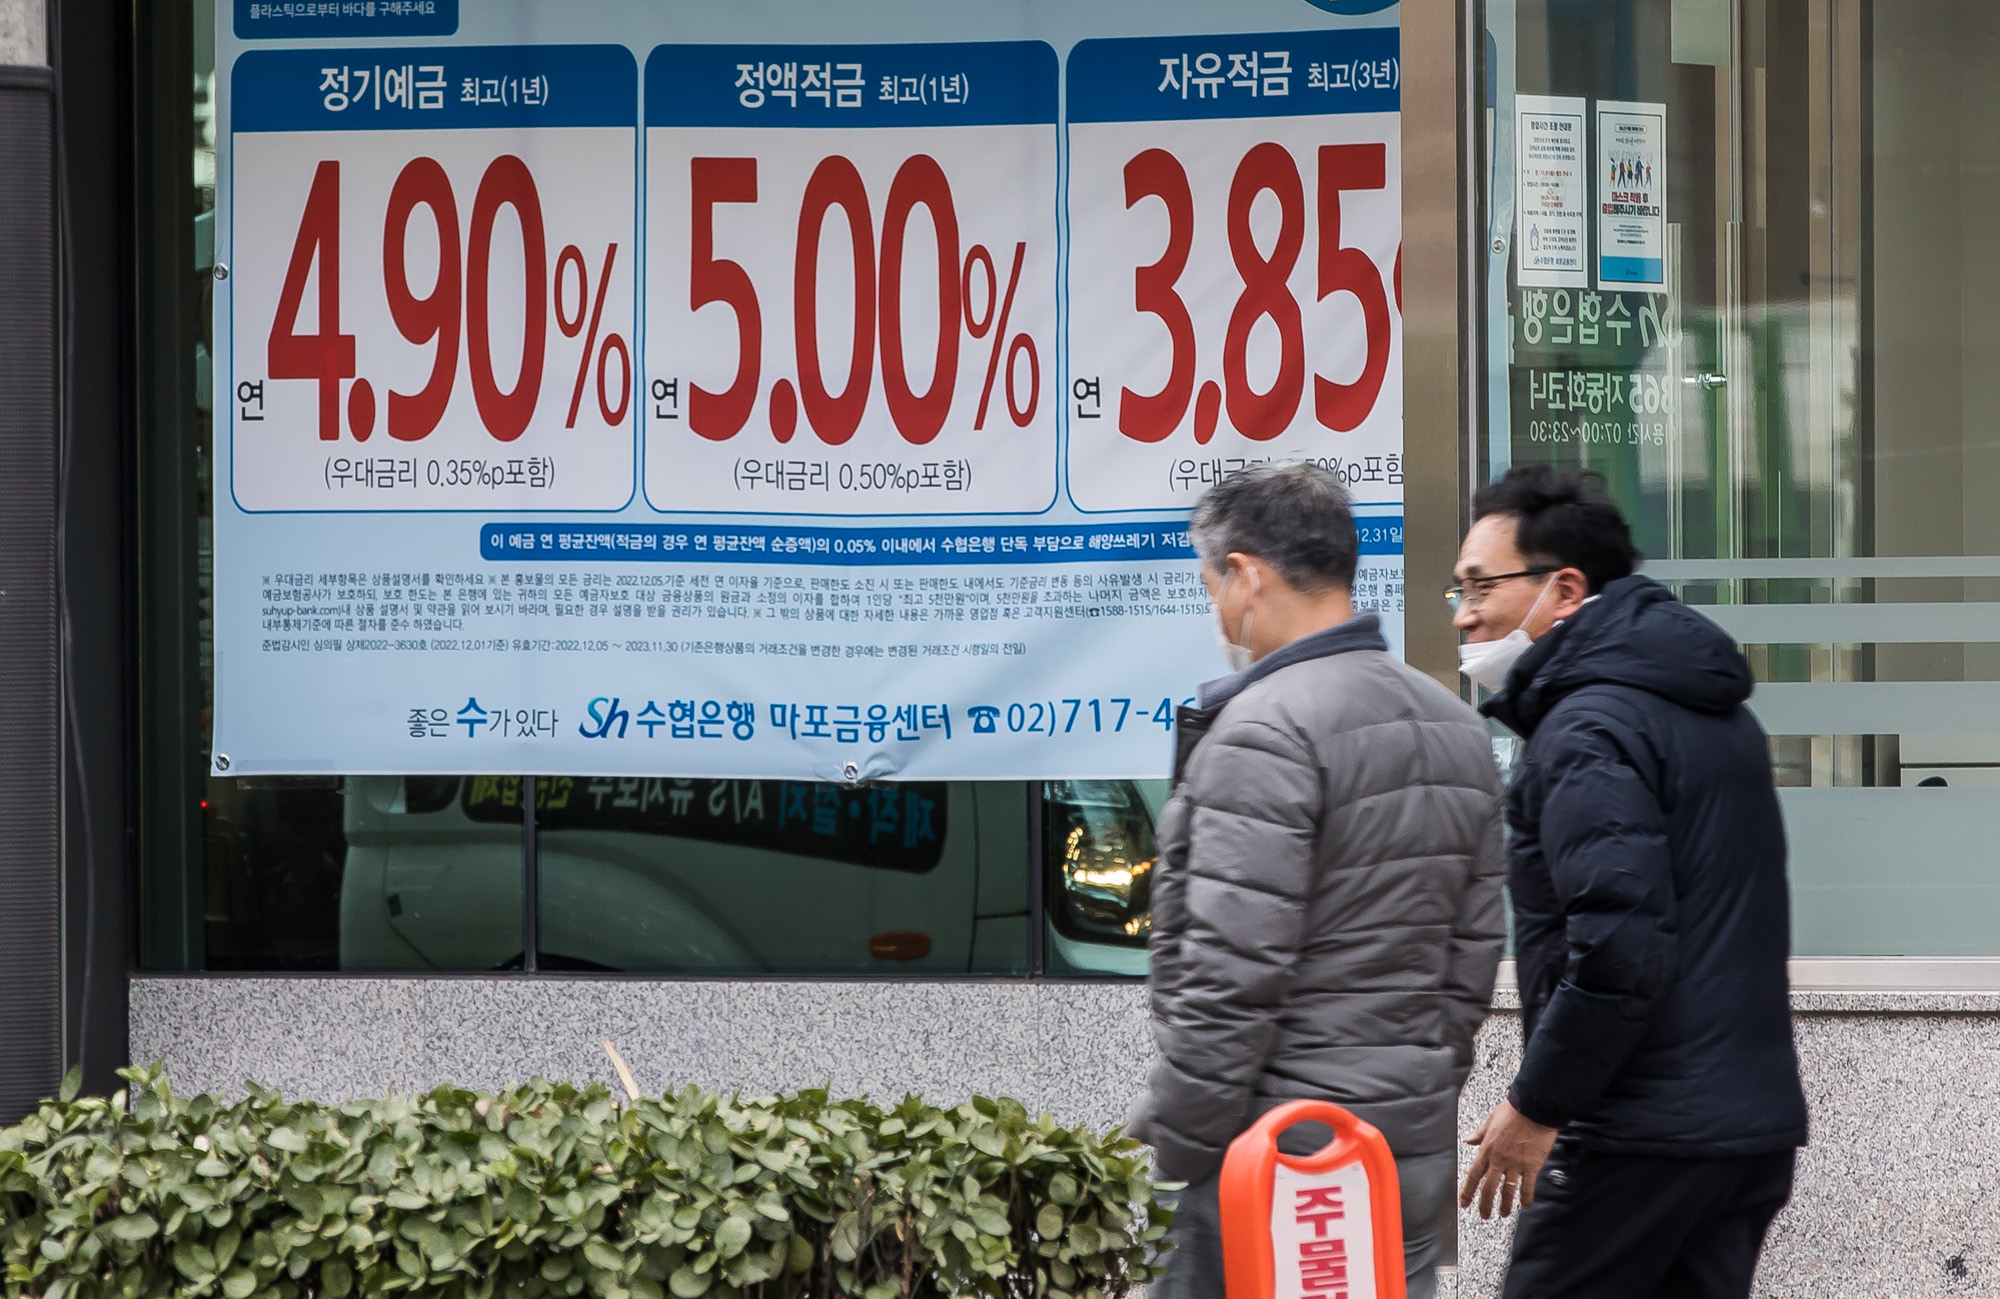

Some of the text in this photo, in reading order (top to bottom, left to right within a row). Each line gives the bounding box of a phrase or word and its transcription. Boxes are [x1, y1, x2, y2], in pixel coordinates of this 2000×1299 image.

[250, 2, 339, 19] 플라스틱으로부터
[342, 1, 376, 17] 바다를
[318, 65, 550, 112] 정기예금 최고(1년)
[734, 62, 969, 109] 정액적금 최고(1년)
[1158, 50, 1399, 100] 자유적금 최고(3년)
[237, 154, 631, 443] 연 4.90%
[651, 153, 1040, 446] 연 5.00%
[1073, 142, 1403, 446] 연 3.85
[324, 456, 555, 490] (우대금리 0.35%p포함)
[733, 457, 971, 493] (우대금리 0.50%p포함)
[491, 534, 503, 549] 이
[509, 534, 535, 549] 예금
[540, 534, 553, 549] 연
[558, 534, 657, 550] 평균잔액(적금의
[663, 534, 688, 550] 경우
[694, 535, 707, 550] 연
[713, 535, 765, 551] 평균잔액
[834, 539, 876, 553] 0.05%
[882, 538, 935, 553] 이내에서
[941, 537, 995, 553] 수협은행
[1001, 536, 1028, 552] 단독
[1033, 536, 1084, 551] 부담으로
[1088, 533, 1155, 550] 해양쓰레기
[262, 588, 332, 602] 예금보험공사가
[383, 588, 404, 602] 보호
[407, 588, 437, 602] 한도는
[442, 588, 453, 601] 본
[457, 588, 488, 603] 은행에
[492, 588, 512, 603] 있는
[517, 588, 548, 603] 귀하의
[552, 589, 573, 603] 모든
[578, 589, 630, 604] 예금자보호
[635, 589, 657, 605] 대상
[661, 590, 714, 606] 금융상품의
[720, 590, 751, 606] 원금과
[756, 591, 787, 605] 소정의
[792, 591, 824, 608] 이자를
[830, 592, 860, 607] 합하여
[866, 593, 894, 607] 1인당
[996, 591, 1040, 607] 5천만원을
[1042, 590, 1084, 604] 초과하는
[1088, 588, 1124, 604] 나머지
[1128, 587, 1162, 603] 금액은
[274, 573, 314, 587] 우대금리
[318, 573, 368, 587] 세부항목은
[371, 573, 430, 587] 상품설명서를
[435, 573, 485, 586] 확인하세요
[500, 573, 511, 587] 본
[514, 573, 554, 588] 홍보물의
[558, 573, 578, 586] 모든
[582, 574, 613, 587] 금리는
[689, 575, 709, 589] 세전
[714, 575, 724, 588] 연
[728, 576, 759, 589] 이자율
[810, 578, 851, 592] 판매한도
[854, 578, 875, 592] 소진
[879, 578, 889, 592] 시
[893, 578, 915, 592] 또는
[919, 578, 960, 592] 판매한도
[963, 577, 1005, 591] 내에서도
[1009, 576, 1047, 590] 기준금리
[1051, 575, 1069, 588] 변동
[1073, 574, 1095, 588] 등의
[1099, 572, 1144, 588] 사유발생
[1147, 572, 1160, 587] 시
[1162, 572, 1195, 587] 금리가
[354, 603, 375, 616] 상품
[379, 603, 408, 618] 설명서
[412, 603, 424, 618] 및
[426, 603, 458, 618] 약관을
[461, 603, 480, 616] 읽어
[484, 603, 514, 616] 보시기
[554, 604, 584, 617] 필요한
[588, 604, 608, 617] 경우
[612, 604, 642, 618] 설명을
[646, 604, 667, 618] 받을
[671, 605, 702, 618] 권리가
[765, 607, 776, 618] 그
[780, 607, 800, 620] 밖의
[804, 607, 835, 622] 상품에
[839, 609, 859, 622] 대한
[863, 608, 896, 622] 자세한
[899, 608, 929, 622] 내용은
[933, 606, 965, 621] 가까운
[969, 606, 998, 621] 영업점
[1002, 606, 1021, 620] 혹은
[406, 708, 450, 738] 좋은
[516, 708, 559, 738] 있다
[636, 699, 755, 741] 수협은행
[769, 702, 952, 743] 마포금융센터
[1008, 697, 1195, 737] 02)717-4
